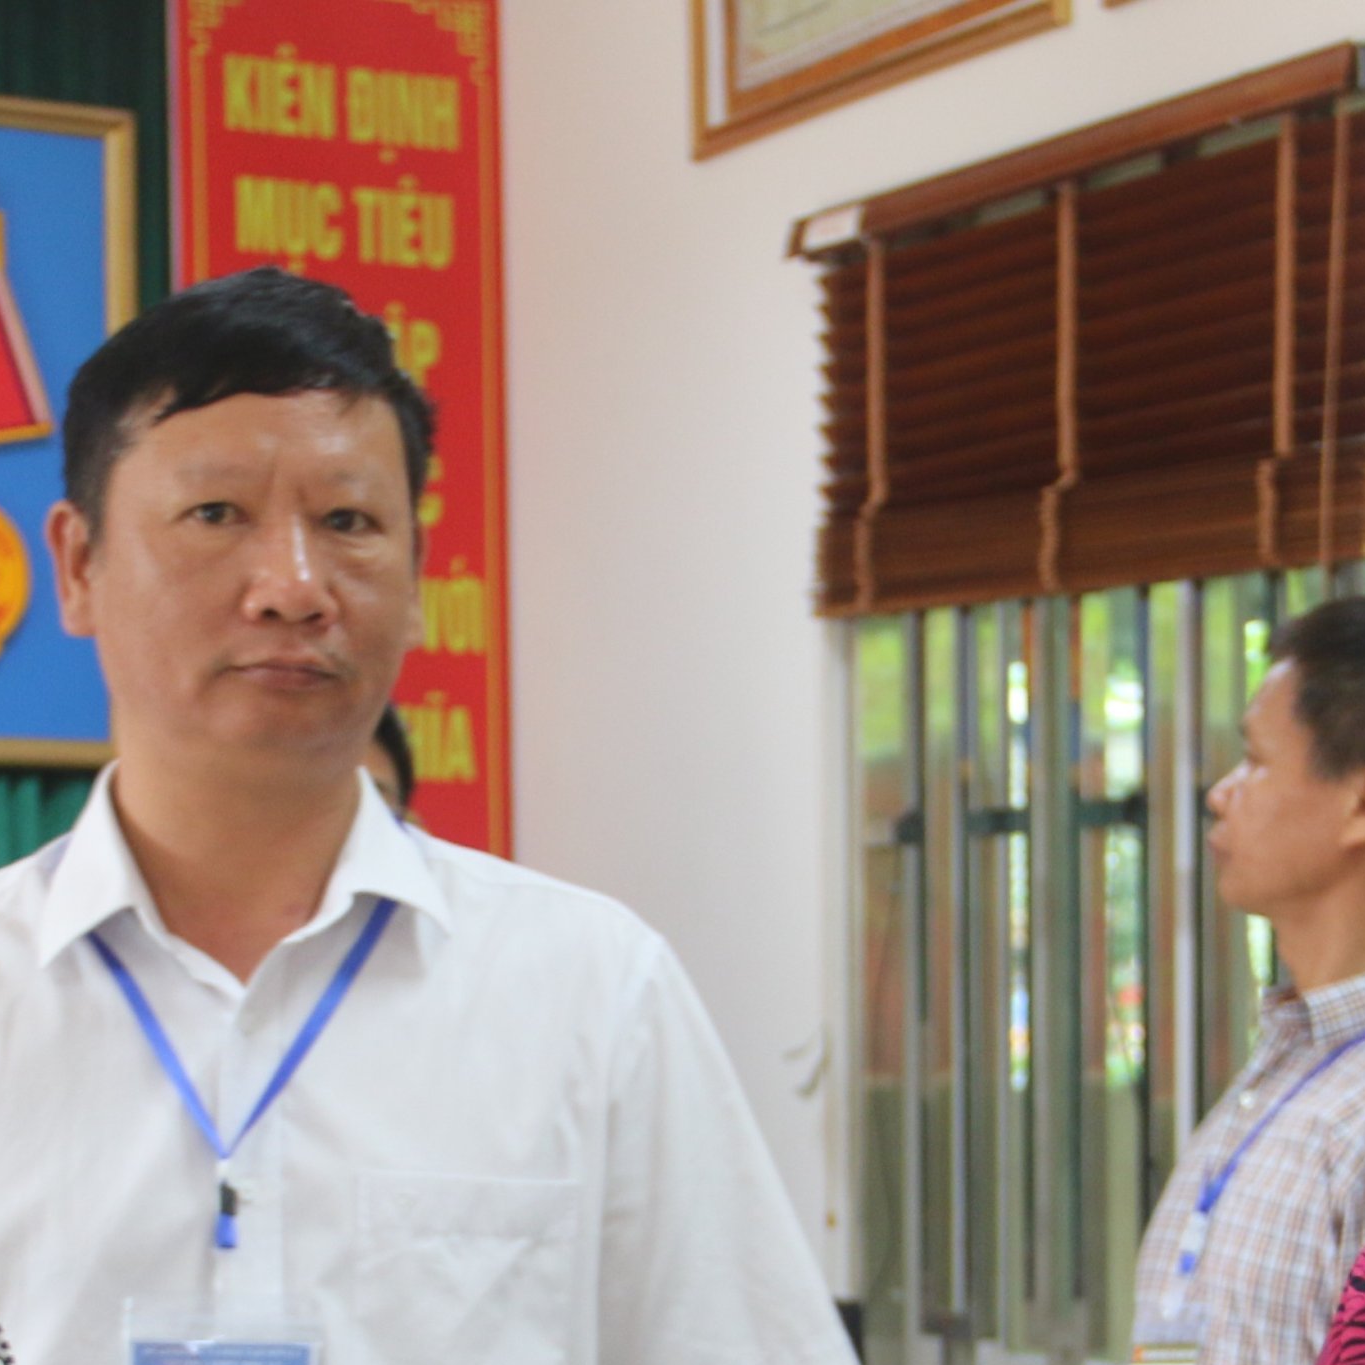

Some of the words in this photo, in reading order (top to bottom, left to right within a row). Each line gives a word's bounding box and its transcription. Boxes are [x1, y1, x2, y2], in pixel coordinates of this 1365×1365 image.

[223, 43, 335, 140] KIÊN
[345, 66, 459, 165] ĐỊNH
[235, 174, 343, 276] MỤC
[351, 174, 455, 271] TIÊU
